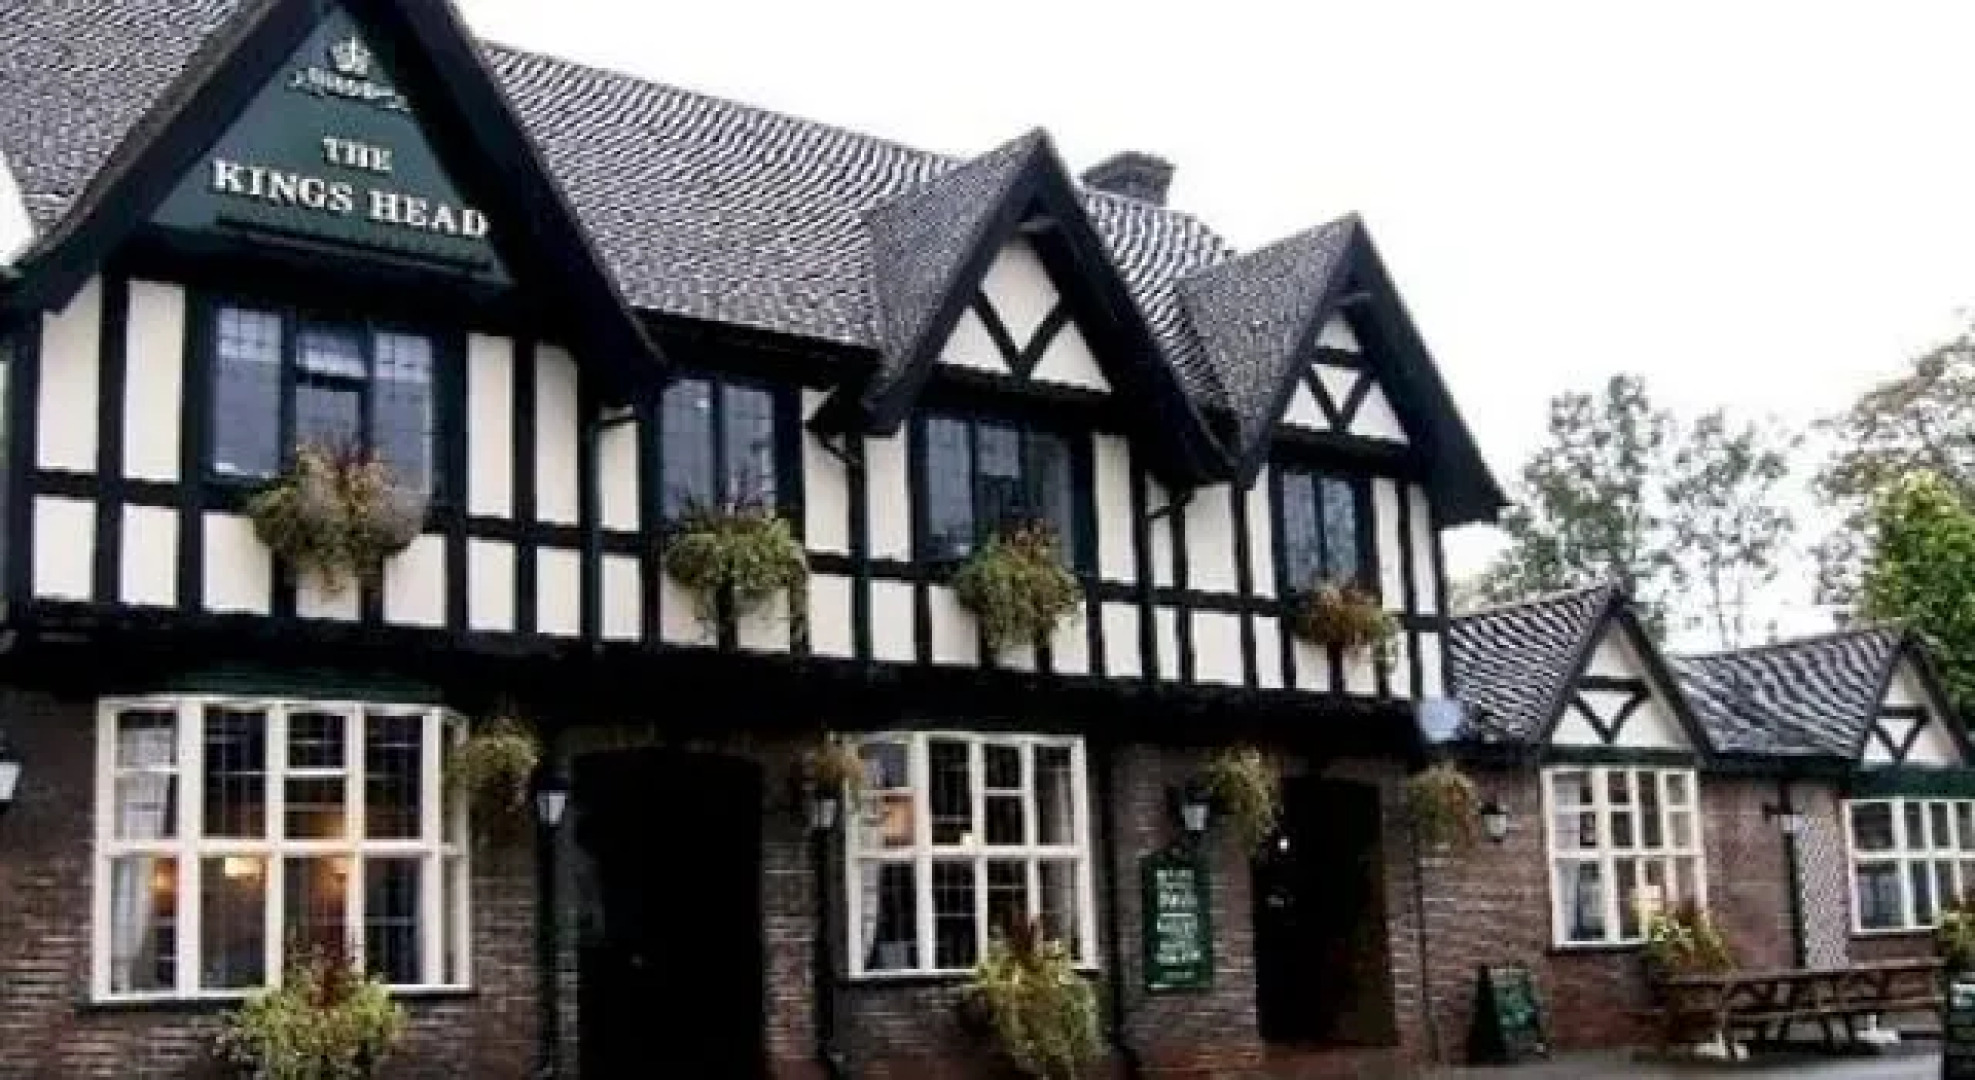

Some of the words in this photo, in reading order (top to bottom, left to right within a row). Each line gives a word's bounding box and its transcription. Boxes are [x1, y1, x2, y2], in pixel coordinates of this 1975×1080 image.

[322, 136, 392, 171] THE
[212, 159, 353, 212] KINGS
[368, 190, 490, 237] HEAD
